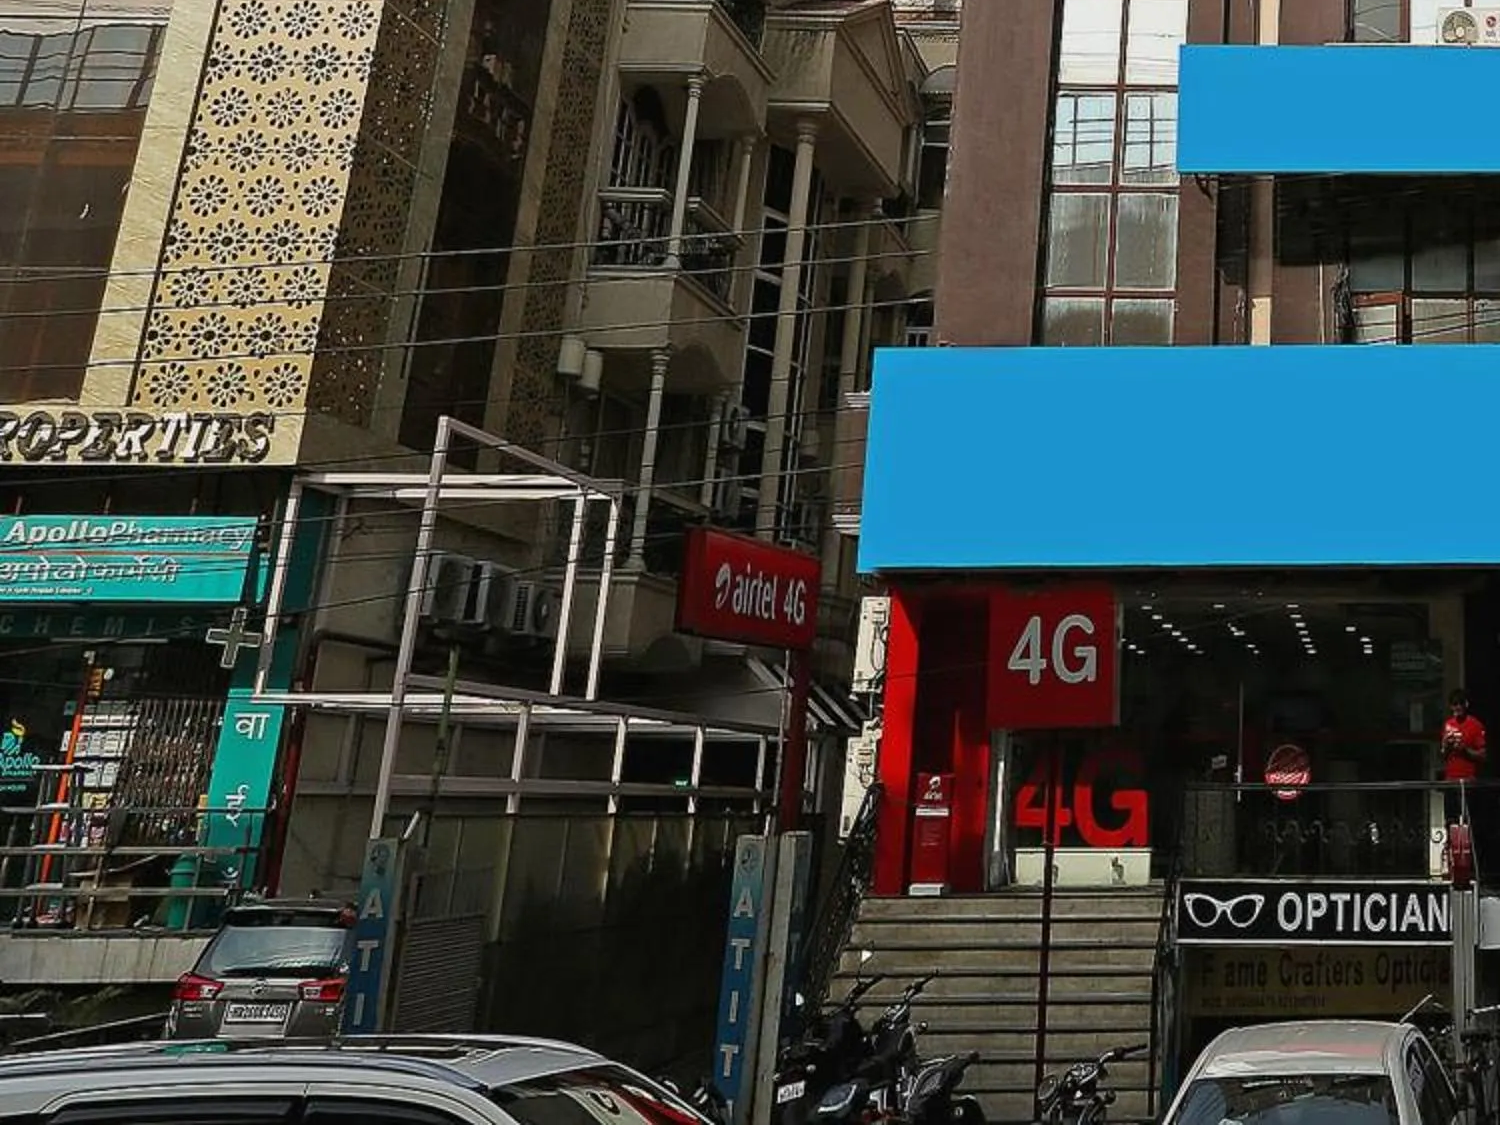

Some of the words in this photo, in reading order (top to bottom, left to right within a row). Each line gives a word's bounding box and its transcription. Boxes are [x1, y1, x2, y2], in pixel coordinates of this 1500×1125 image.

[733, 562, 777, 620] airtel
[783, 575, 807, 626] 4G
[1007, 614, 1098, 686] 4G
[1015, 748, 1150, 848] 4G
[1277, 891, 1453, 933] OPTICIAN
[1278, 952, 1364, 989] Crafters
